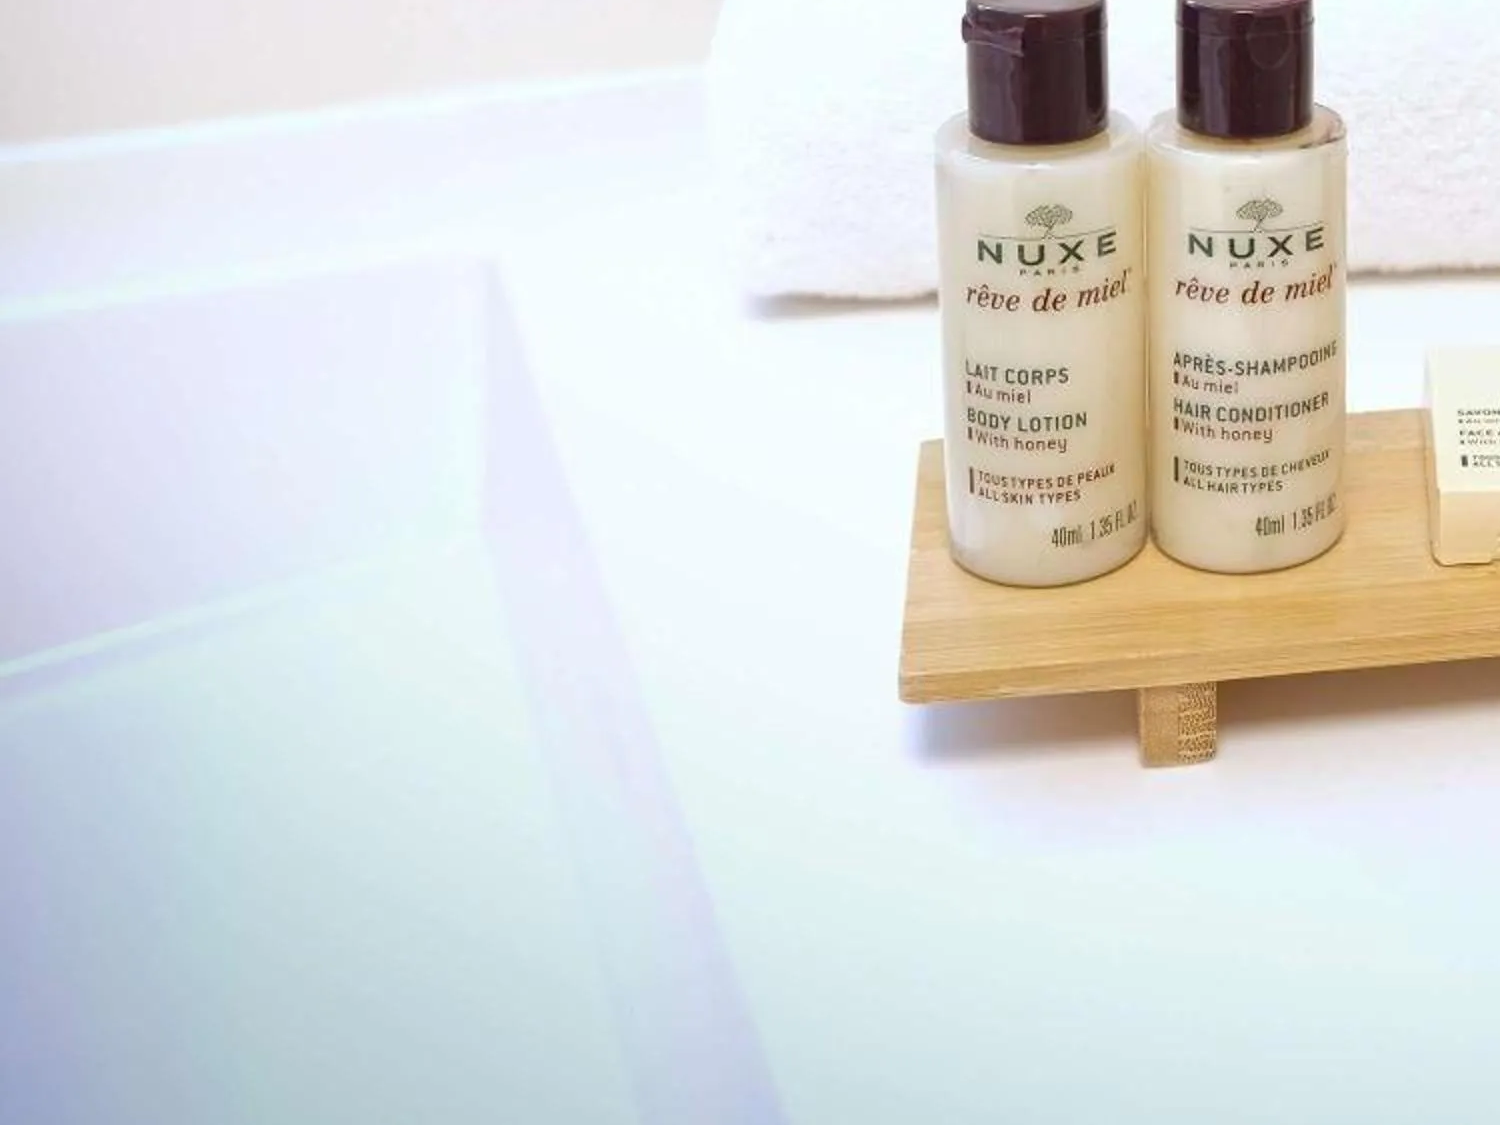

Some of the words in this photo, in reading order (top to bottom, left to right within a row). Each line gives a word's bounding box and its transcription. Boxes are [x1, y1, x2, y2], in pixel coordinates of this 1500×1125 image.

[978, 230, 1117, 266] NUXE
[1188, 227, 1324, 259] NUXE
[1019, 266, 1079, 276] PARIS
[1229, 259, 1288, 269] PARIS
[966, 284, 1021, 312] rêve
[1032, 288, 1067, 312] de
[1078, 268, 1128, 308] miel
[1175, 277, 1229, 304] rêve
[1242, 281, 1275, 304] de
[1285, 263, 1334, 300] miel
[965, 359, 998, 381] LAIT
[1005, 367, 1069, 385] CORPS
[975, 383, 992, 399] Au
[997, 389, 1031, 404] miel
[1182, 375, 1199, 389] Au
[1203, 381, 1238, 393] miel
[1174, 397, 1210, 420] HAIR
[1216, 391, 1329, 423] CONDITIONER
[967, 407, 1011, 430] BODY
[1018, 412, 1087, 432] LOTION
[1182, 418, 1215, 439] With
[1221, 427, 1273, 443] honey
[976, 429, 1008, 449] With
[1014, 437, 1067, 453] honey
[1459, 428, 1493, 436] FACE
[979, 470, 1007, 487] TOUS
[1011, 476, 1053, 489] TYPES
[1057, 476, 1073, 487] DE
[1077, 463, 1115, 485] PEAUX
[1184, 460, 1213, 476] TOUS
[1216, 466, 1257, 479] TYPES
[1262, 465, 1279, 477] DE
[979, 487, 998, 501] ALL
[1002, 492, 1033, 505] SKIN
[1039, 489, 1081, 504] TYPES
[1184, 476, 1203, 490] ALL
[1207, 481, 1238, 494] HAIR
[1242, 480, 1283, 493] TYPES
[1051, 525, 1083, 547] 40ml
[1255, 514, 1285, 536] 40ml
